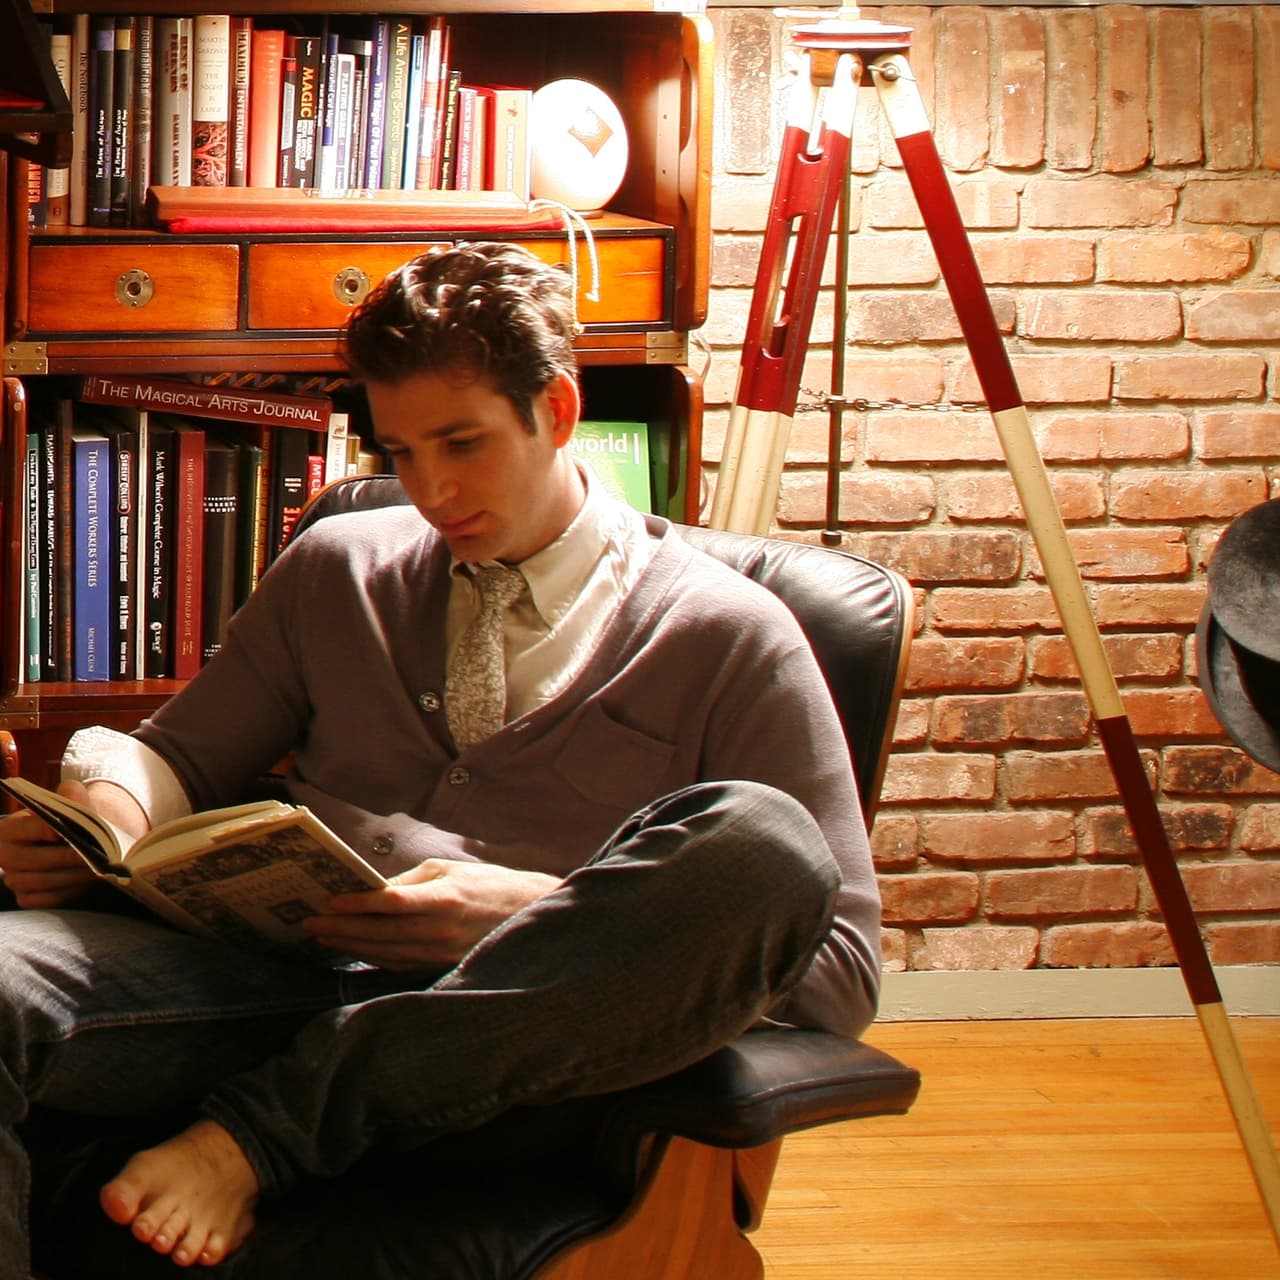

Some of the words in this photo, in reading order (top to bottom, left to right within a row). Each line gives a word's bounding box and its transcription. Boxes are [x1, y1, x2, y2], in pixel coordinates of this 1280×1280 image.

[395, 35, 407, 55] Life
[397, 24, 408, 33] A
[237, 34, 247, 83] MAXIMUM
[391, 59, 404, 98] Among
[302, 66, 315, 117] MAGIC
[235, 90, 247, 170] ENTERTAINMENT
[390, 101, 403, 140] Secrets
[99, 379, 131, 400] THE
[136, 384, 209, 409] MAGICAL
[212, 394, 254, 416] ARTS
[259, 404, 329, 426] JOURNAL
[88, 450, 99, 467] THE
[88, 470, 99, 513] COMPLETE
[88, 516, 99, 557] WORKERS
[88, 560, 99, 587] SERIES
